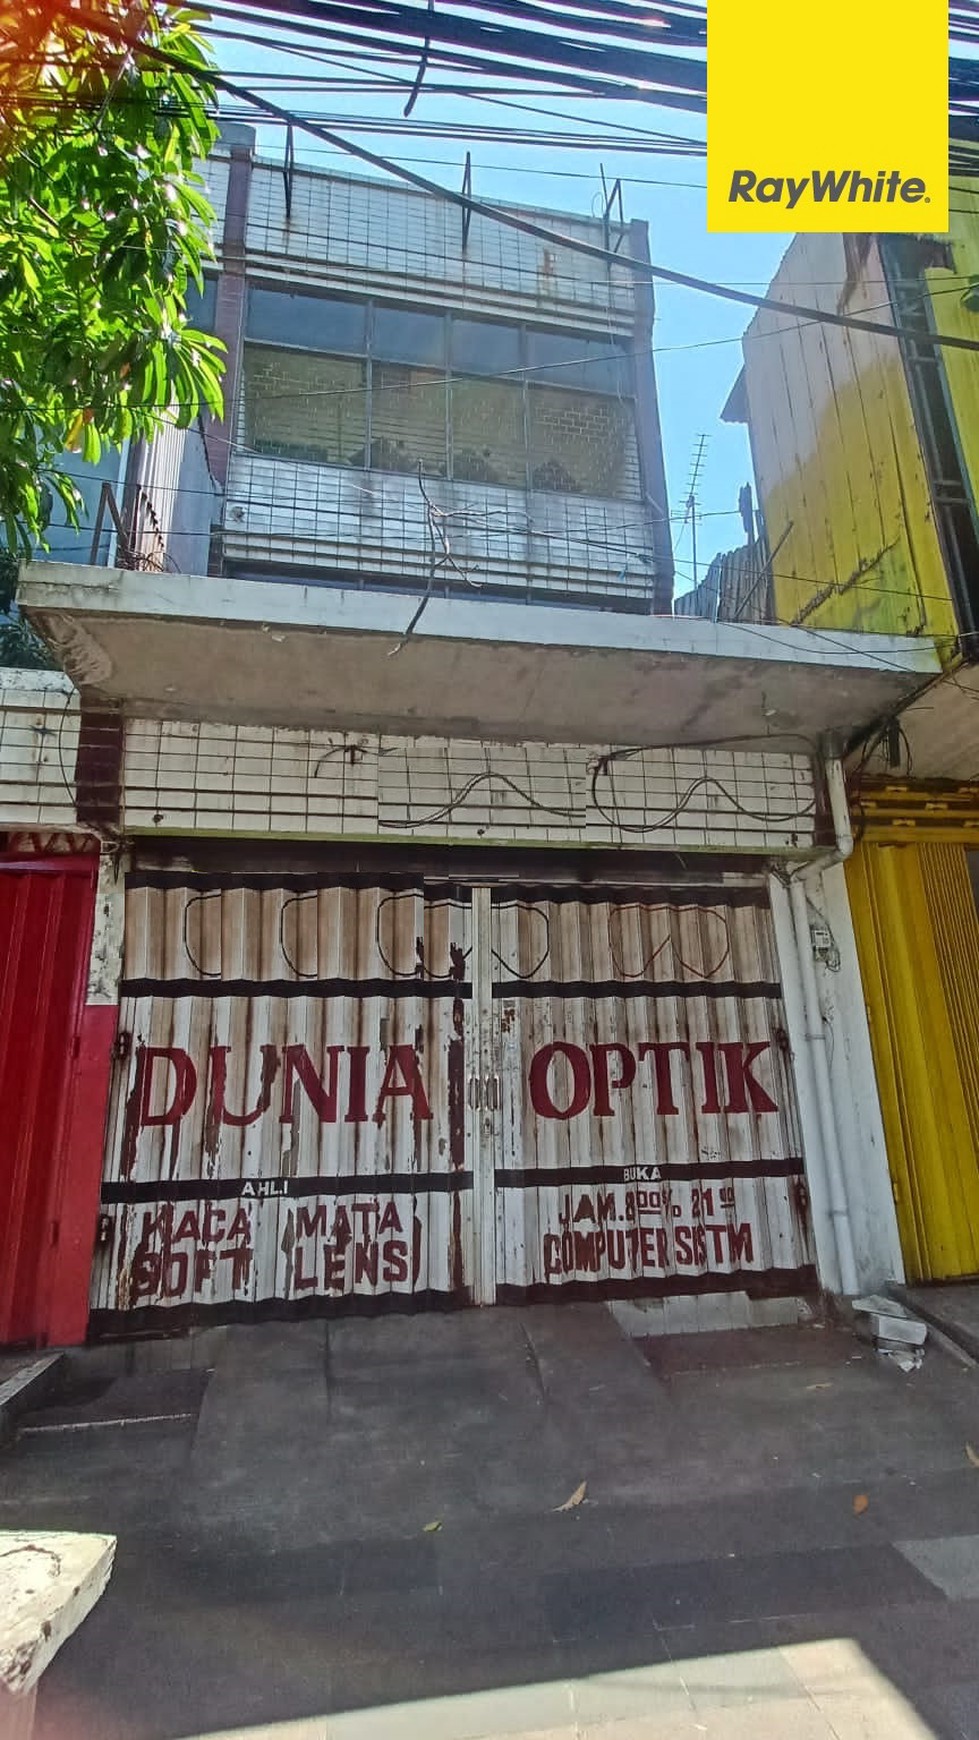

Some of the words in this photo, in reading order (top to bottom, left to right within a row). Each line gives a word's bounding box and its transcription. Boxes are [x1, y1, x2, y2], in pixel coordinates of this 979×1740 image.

[138, 1044, 434, 1127] DUNIA
[528, 1041, 779, 1119] OPTIK
[623, 1167, 662, 1182] BUKA
[140, 1208, 252, 1244] KACA
[296, 1200, 403, 1239] MATA
[131, 1248, 254, 1297] SOFT
[294, 1240, 408, 1290] LENS
[543, 1227, 669, 1277] COMPUTER
